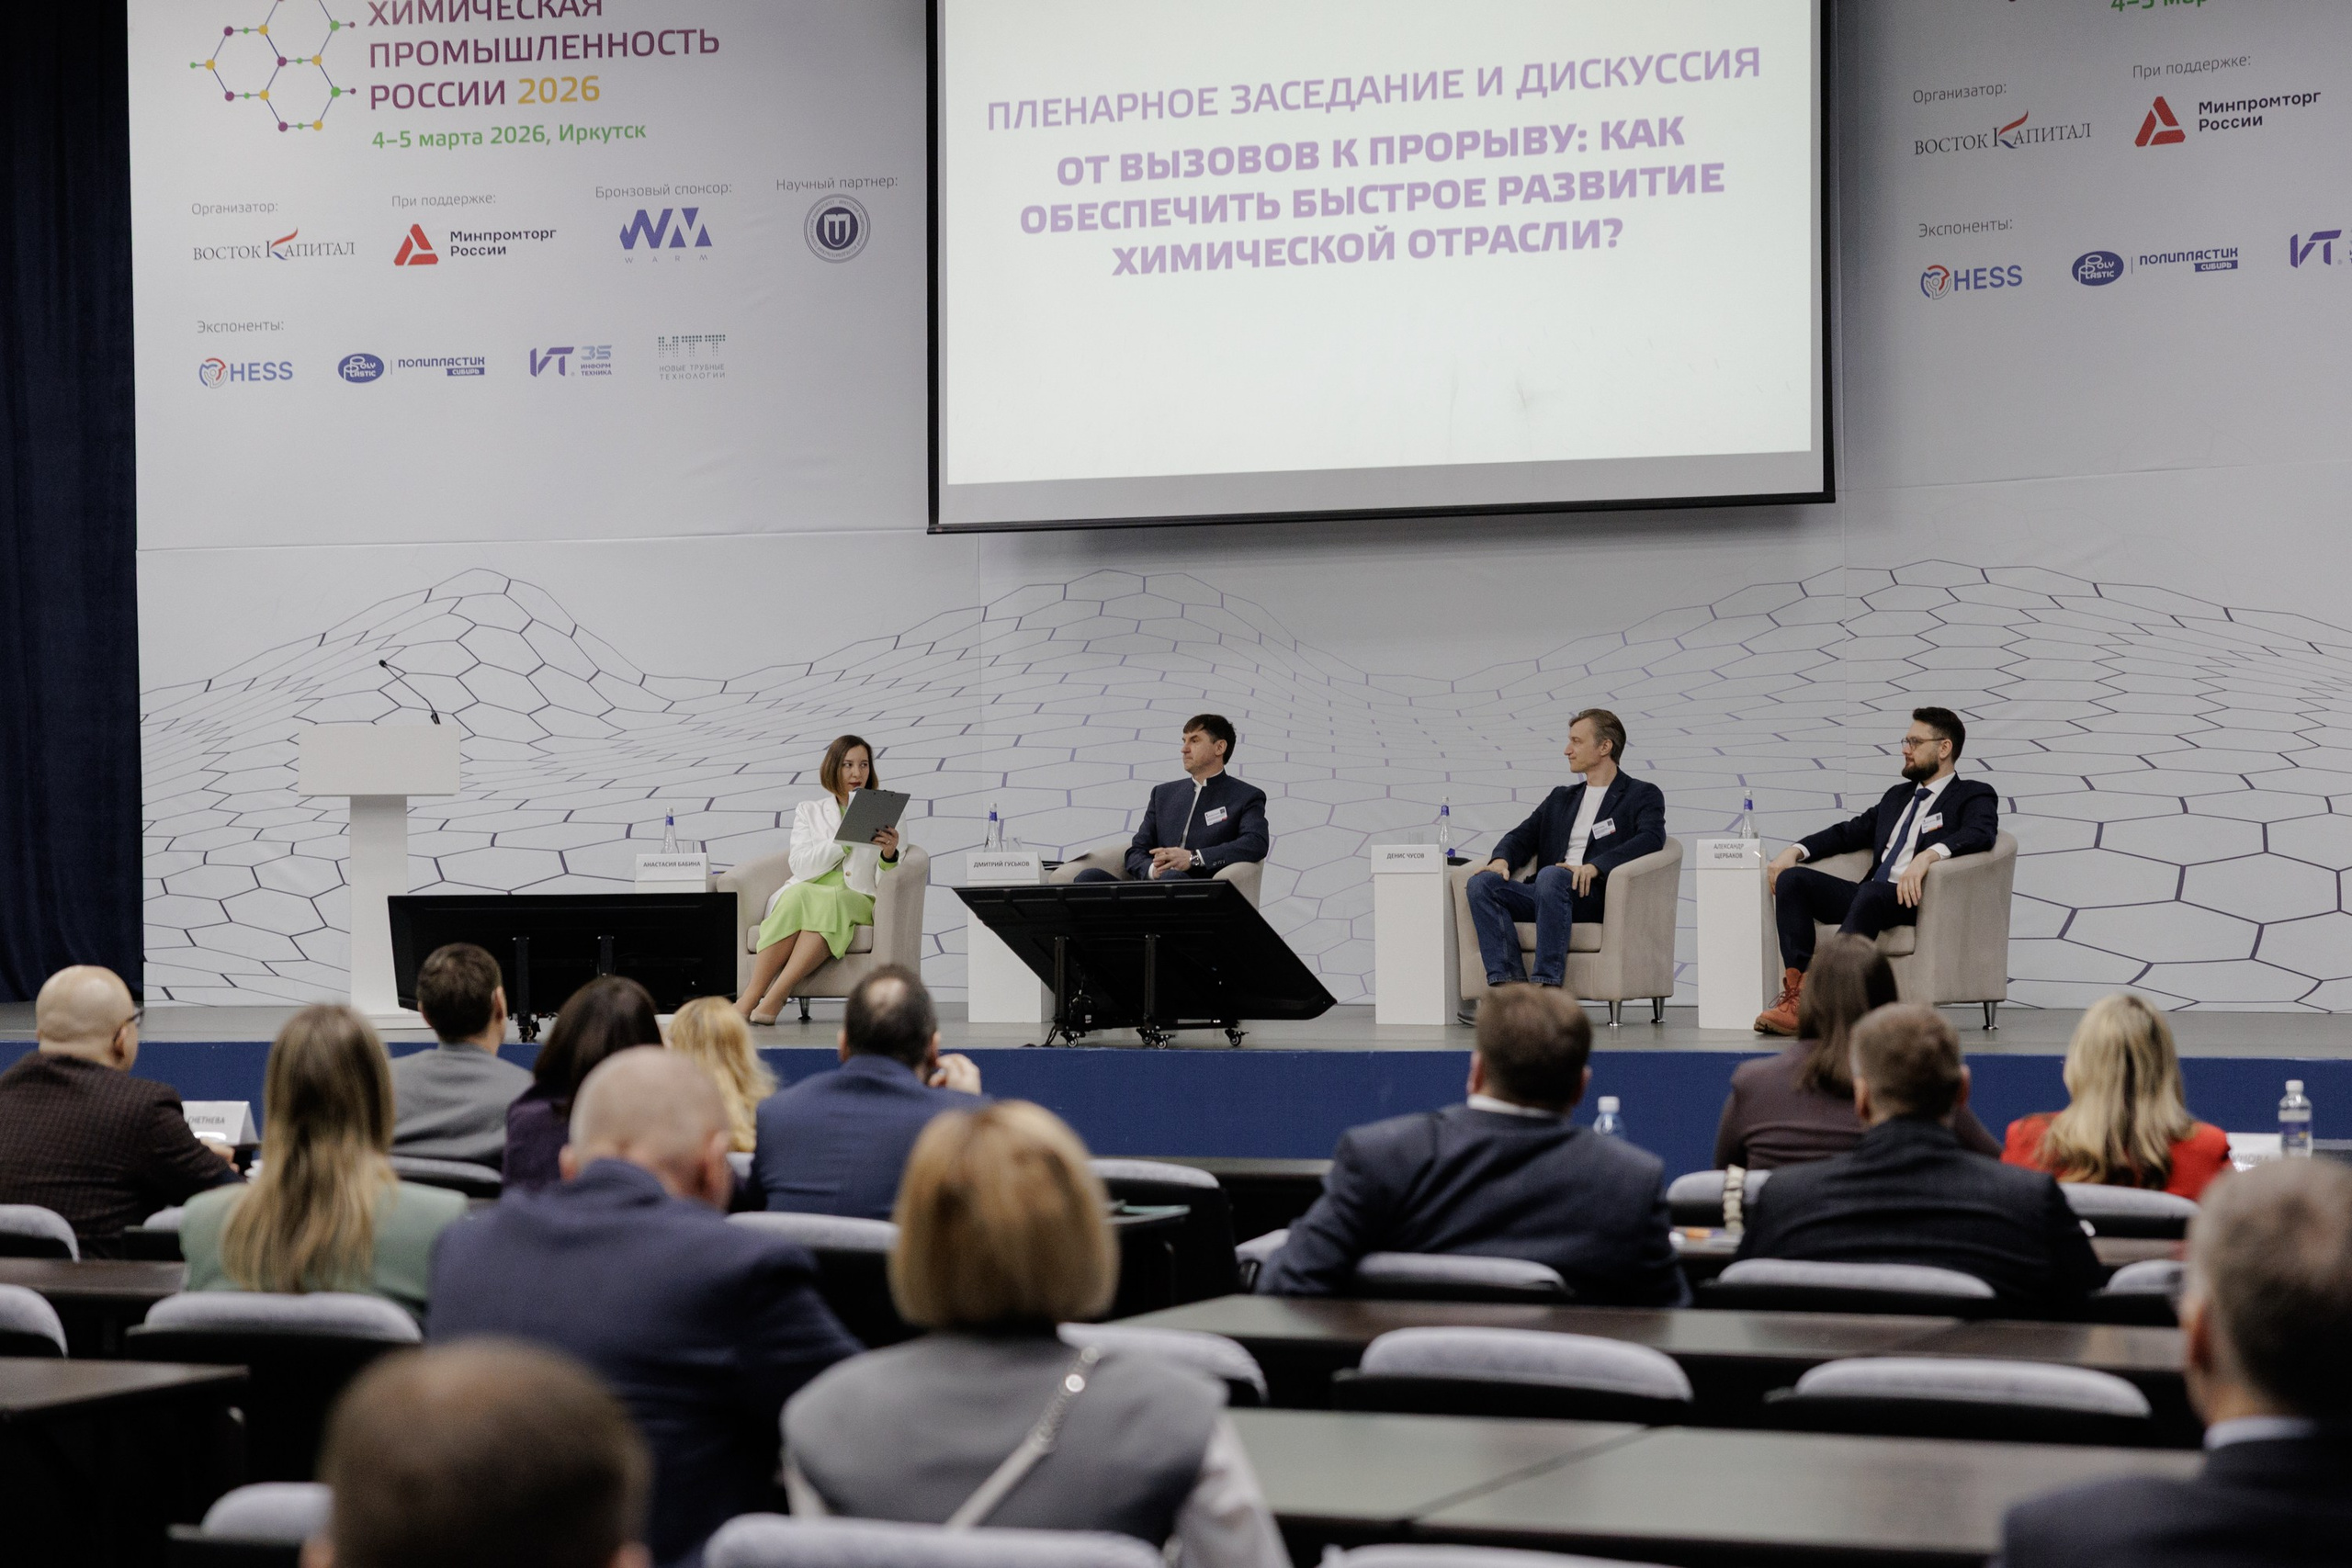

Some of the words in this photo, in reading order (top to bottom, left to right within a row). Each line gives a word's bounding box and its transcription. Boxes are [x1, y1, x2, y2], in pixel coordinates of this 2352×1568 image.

[368, 0, 603, 27] ХИМИЧЕСКАЯ
[369, 28, 720, 68] ПРОМЫШЛЕННОСТЬ
[2132, 65, 2161, 79] При
[2165, 54, 2252, 75] поддержке:
[369, 80, 506, 110] РОССИИ
[517, 75, 601, 105] 2026
[988, 87, 1219, 130] ПЛЕНАРНОЕ
[1230, 68, 1464, 115] ЗАСЕДАНИЕ
[1477, 67, 1504, 97] И
[1516, 47, 1761, 99] ДИСКУССИЯ
[1913, 83, 2007, 104] Организатор:
[2199, 92, 2322, 117] Минпромторг
[1914, 133, 1988, 155] ВОСТОК
[1993, 109, 2091, 149] КАПИТАЛ
[2199, 115, 2263, 132] России
[418, 129, 484, 150] марта
[490, 126, 552, 146] 2026,
[559, 122, 647, 147] Иркутск
[1057, 155, 1109, 186] ОТ
[1120, 141, 1320, 182] ВЫЗОВОВ
[1333, 139, 1359, 167] К
[1368, 124, 1589, 166] ПРОРЫВУ:
[1600, 116, 1686, 151] КАК
[595, 185, 670, 198] Бронзовый
[674, 184, 732, 200] спонсор:
[776, 179, 835, 192] Научный
[840, 176, 898, 194] партнер:
[391, 195, 417, 208] При
[422, 193, 497, 208] поддержке:
[1020, 191, 1282, 233] ОБЕСПЕЧИТЬ
[1291, 178, 1487, 220] БЫСТРОЕ
[1498, 163, 1725, 205] РАЗВИТИЕ
[191, 201, 278, 216] Организатор:
[450, 228, 557, 243] Минпромторг
[1918, 218, 2013, 237] Экспоненты:
[193, 245, 262, 261] ВОСТОК
[266, 227, 356, 261] КАПИТАЛ
[450, 244, 507, 256] России
[1112, 224, 1396, 276] ХИМИЧЕСКОЙ
[1408, 218, 1624, 260] ОТРАСЛИ?
[625, 254, 708, 264] WARM
[2140, 248, 2238, 265] ПОЛИПЛАСТИК
[2200, 262, 2232, 271] СИБИРЬ
[1954, 265, 2023, 291] HESS
[197, 321, 284, 333] Экспоненты:
[398, 356, 485, 367] ПОЛИПЛАСТИК
[231, 362, 293, 381] HESS
[660, 372, 726, 380] ТЕХНОЛОГИИ
